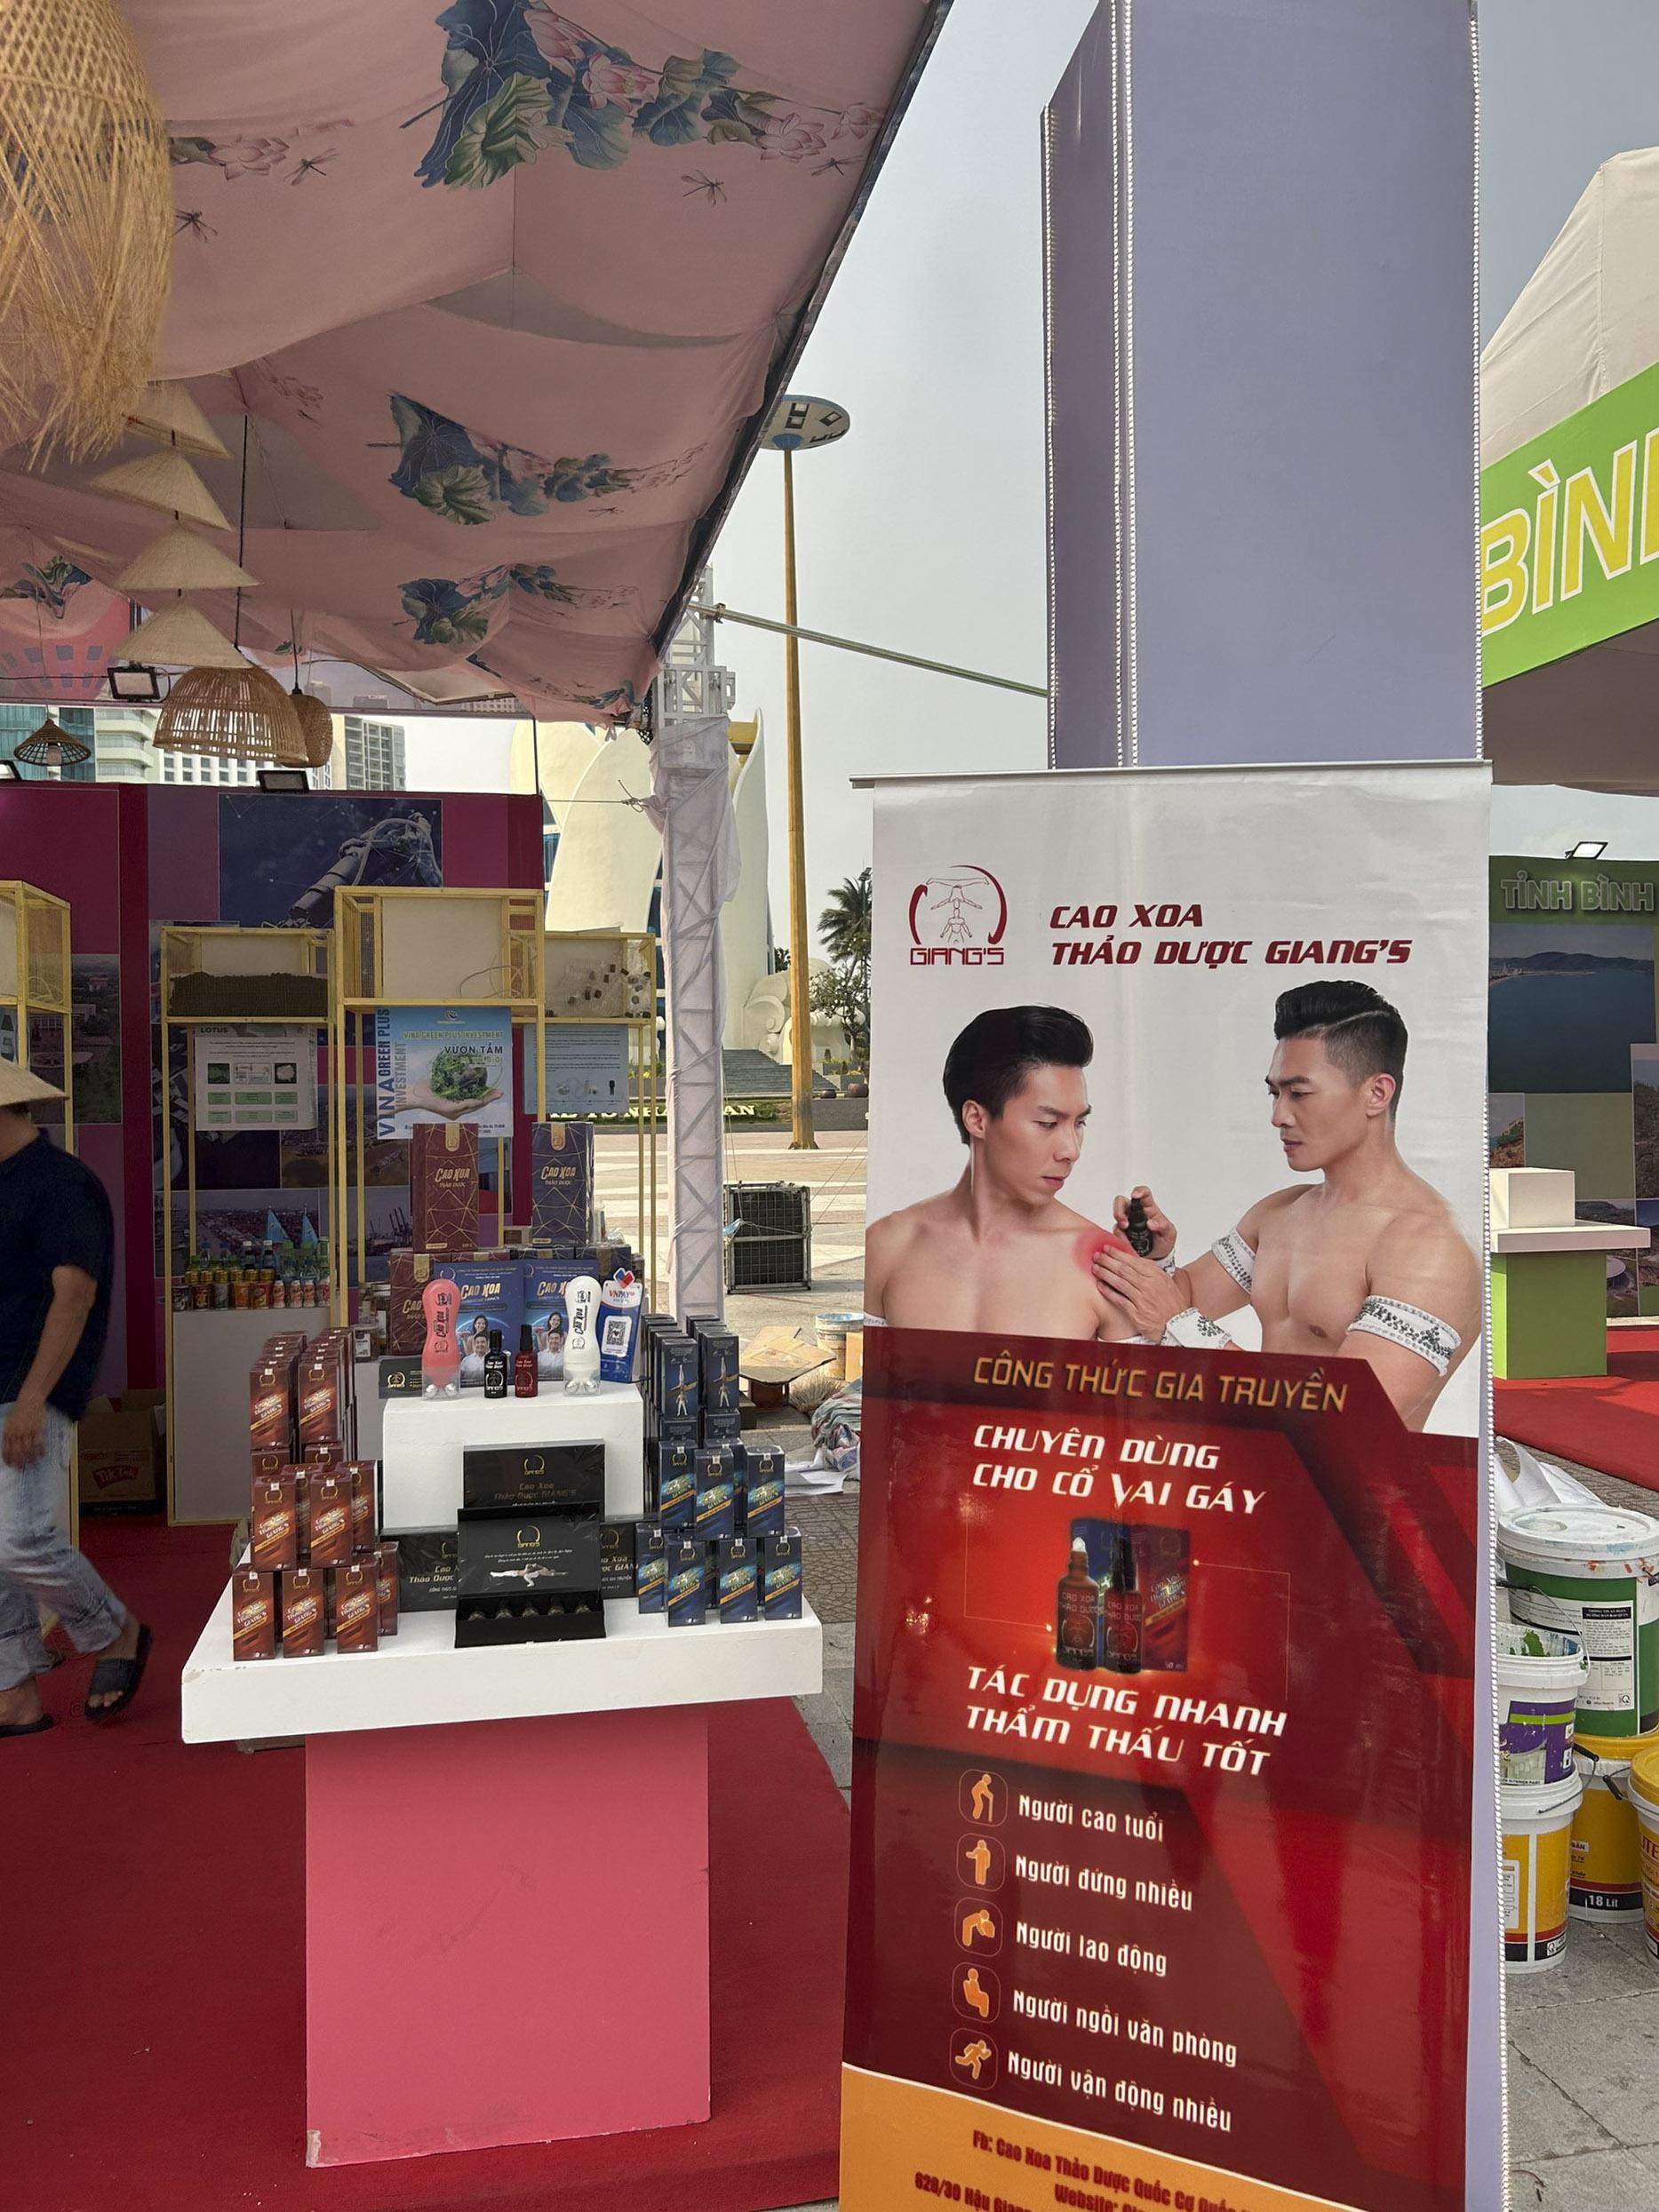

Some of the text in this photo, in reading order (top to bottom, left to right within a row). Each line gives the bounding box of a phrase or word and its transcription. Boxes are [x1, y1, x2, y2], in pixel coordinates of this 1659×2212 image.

[1049, 903, 1203, 928] CAO XOA
[1501, 870, 1654, 911] TỈNH BÌNH
[910, 948, 1004, 966] GIANG'S
[1052, 935, 1412, 969] THẢO DƯỢC GIANG'S
[378, 1008, 395, 1137] VINA GREEN PLUS
[395, 1043, 406, 1107] INVESTMENT
[974, 1350, 1348, 1412] CÔNG THỨC GIA TRUYỀN
[974, 1424, 1220, 1469] CHUYÊN DÙNG
[973, 1464, 1266, 1514] CHO CỔ VAI GÁY
[967, 1666, 1288, 1737] TÁC DỤNG NHANH
[965, 1705, 1272, 1777] THẨM THẤU TỐT
[1018, 1794, 1165, 1842] Người cao tuổi
[1016, 1854, 1193, 1912] Người đứng nhiều
[1588, 1895, 1603, 1907] 18
[1017, 1922, 1168, 1977] Người lao động
[1013, 1991, 1238, 2068] Người ngồi văn phòng
[1008, 2051, 1232, 2132] Người vận động nhiều
[972, 2129, 993, 2152] Fb:
[996, 2137, 1022, 2161] Cao
[1025, 2146, 1052, 2171] Xoa
[1055, 2154, 1089, 2181] Thảo
[1094, 2165, 1130, 2193] Dược
[1134, 2179, 1171, 2206] Quốc
[1199, 2198, 1237, 2212] Quố
[965, 2186, 990, 2211] Hậu
[994, 2197, 1033, 2212] Gia
